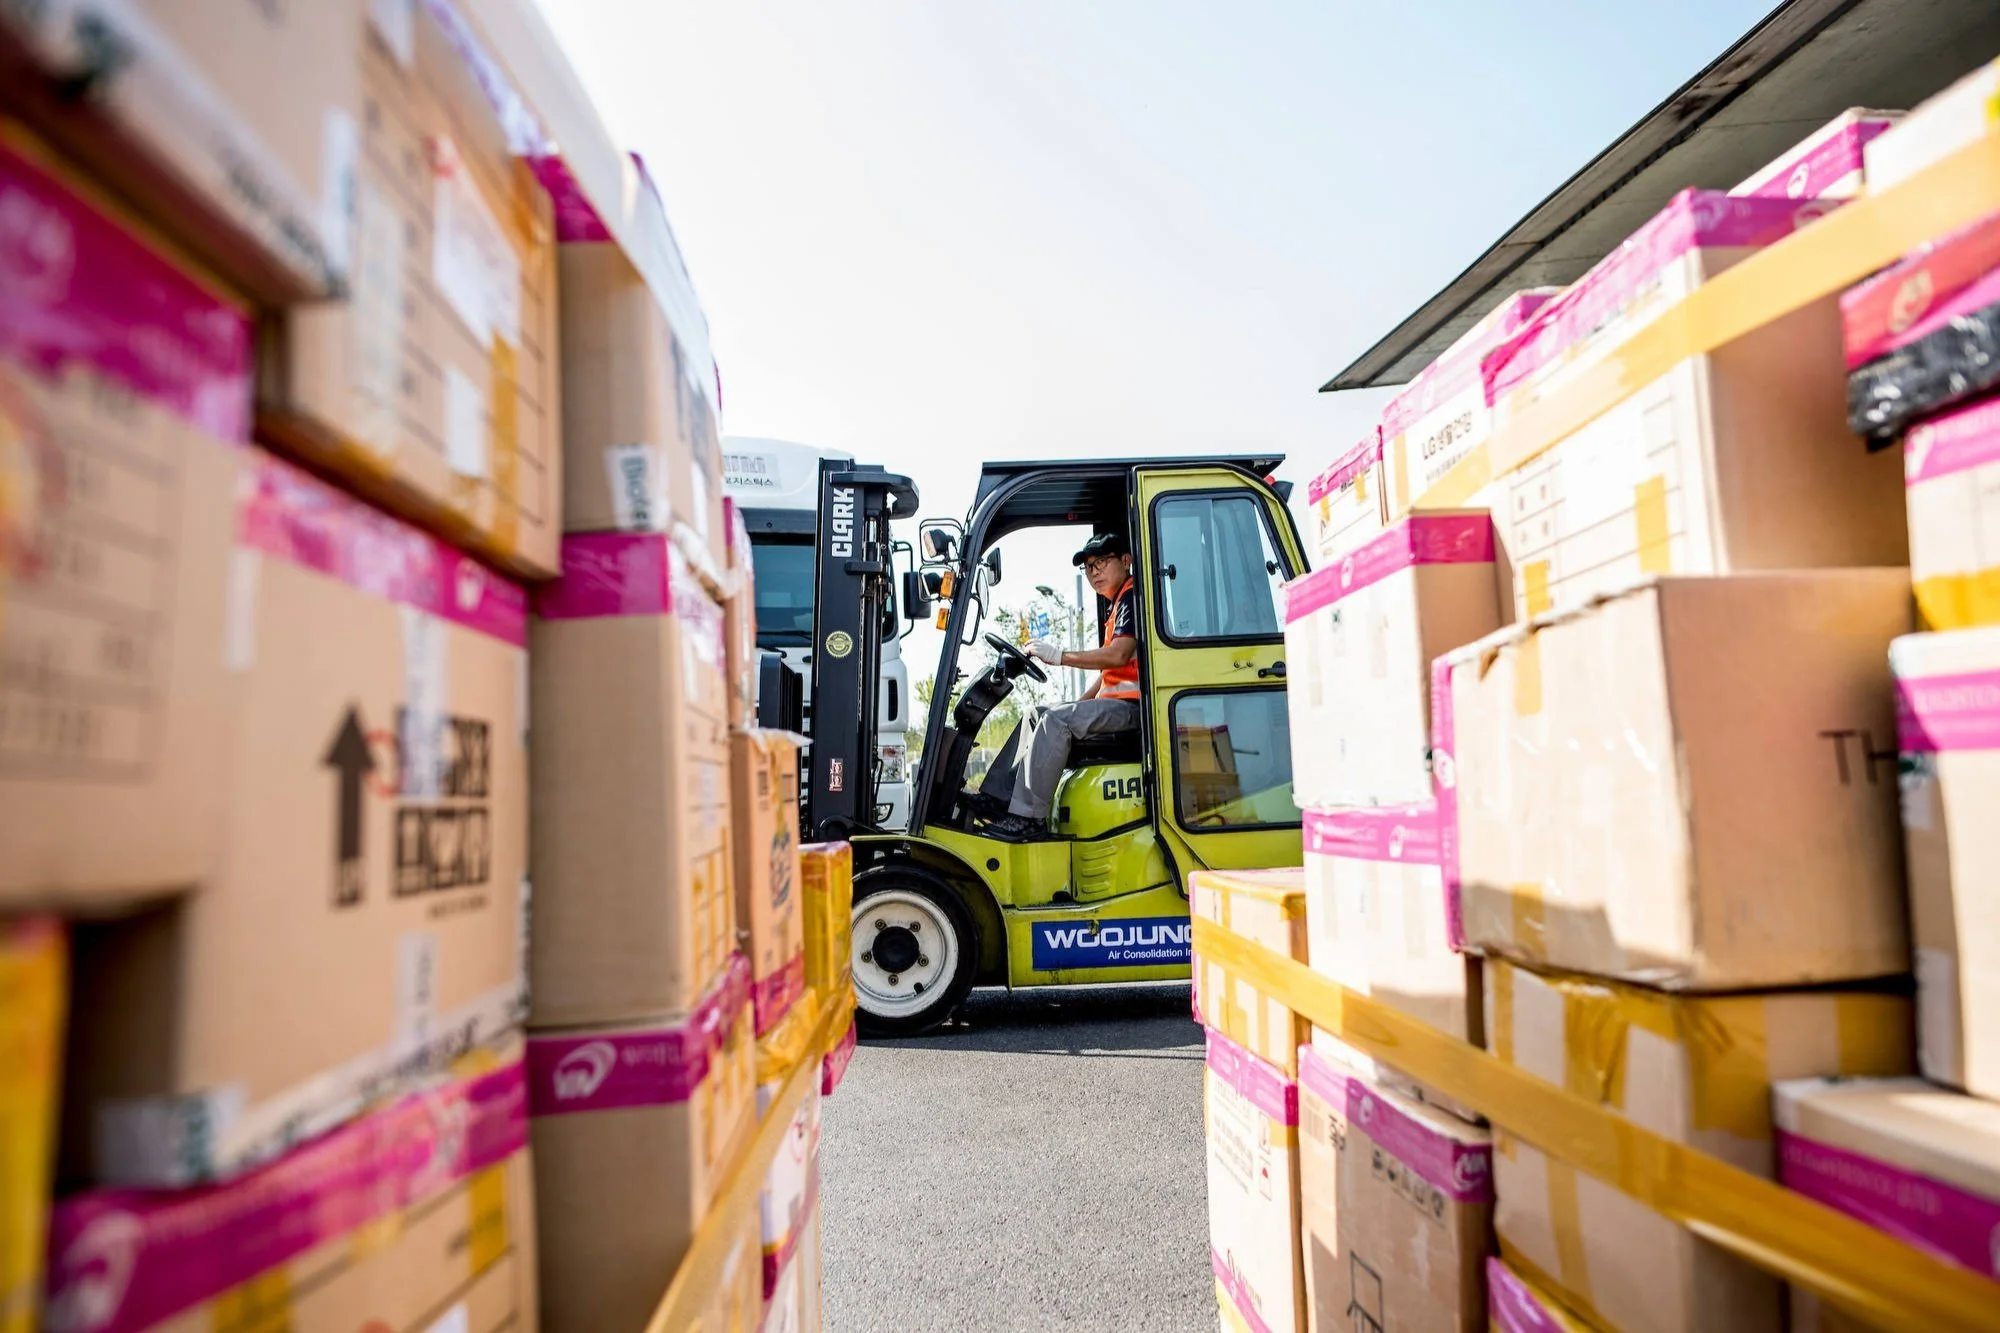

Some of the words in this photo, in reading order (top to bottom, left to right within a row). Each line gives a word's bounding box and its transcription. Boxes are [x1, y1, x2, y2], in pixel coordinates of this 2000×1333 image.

[831, 487, 855, 558] CLARK
[1108, 950, 1121, 960] Air
[1123, 947, 1183, 959] Consolidation
